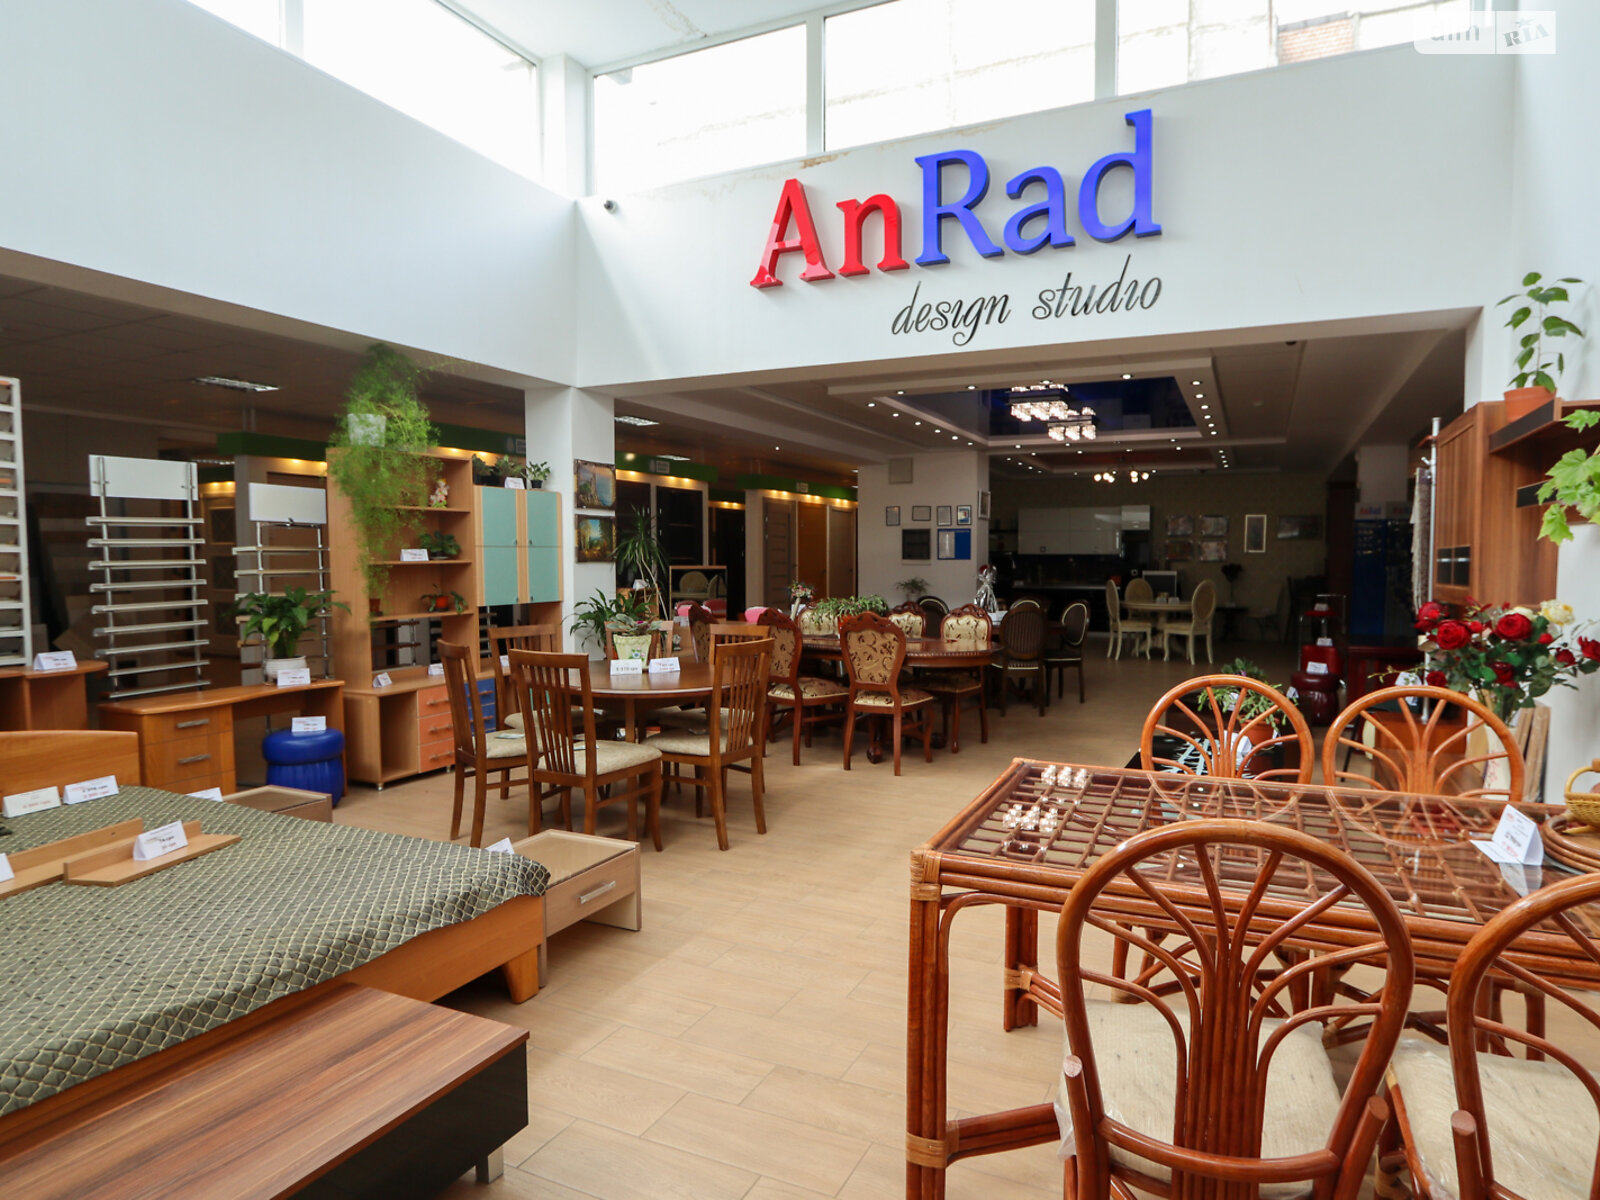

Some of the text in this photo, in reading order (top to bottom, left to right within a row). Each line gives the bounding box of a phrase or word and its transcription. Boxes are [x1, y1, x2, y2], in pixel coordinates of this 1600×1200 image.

[750, 108, 1161, 288] AnRad
[892, 254, 1163, 346] design studio
